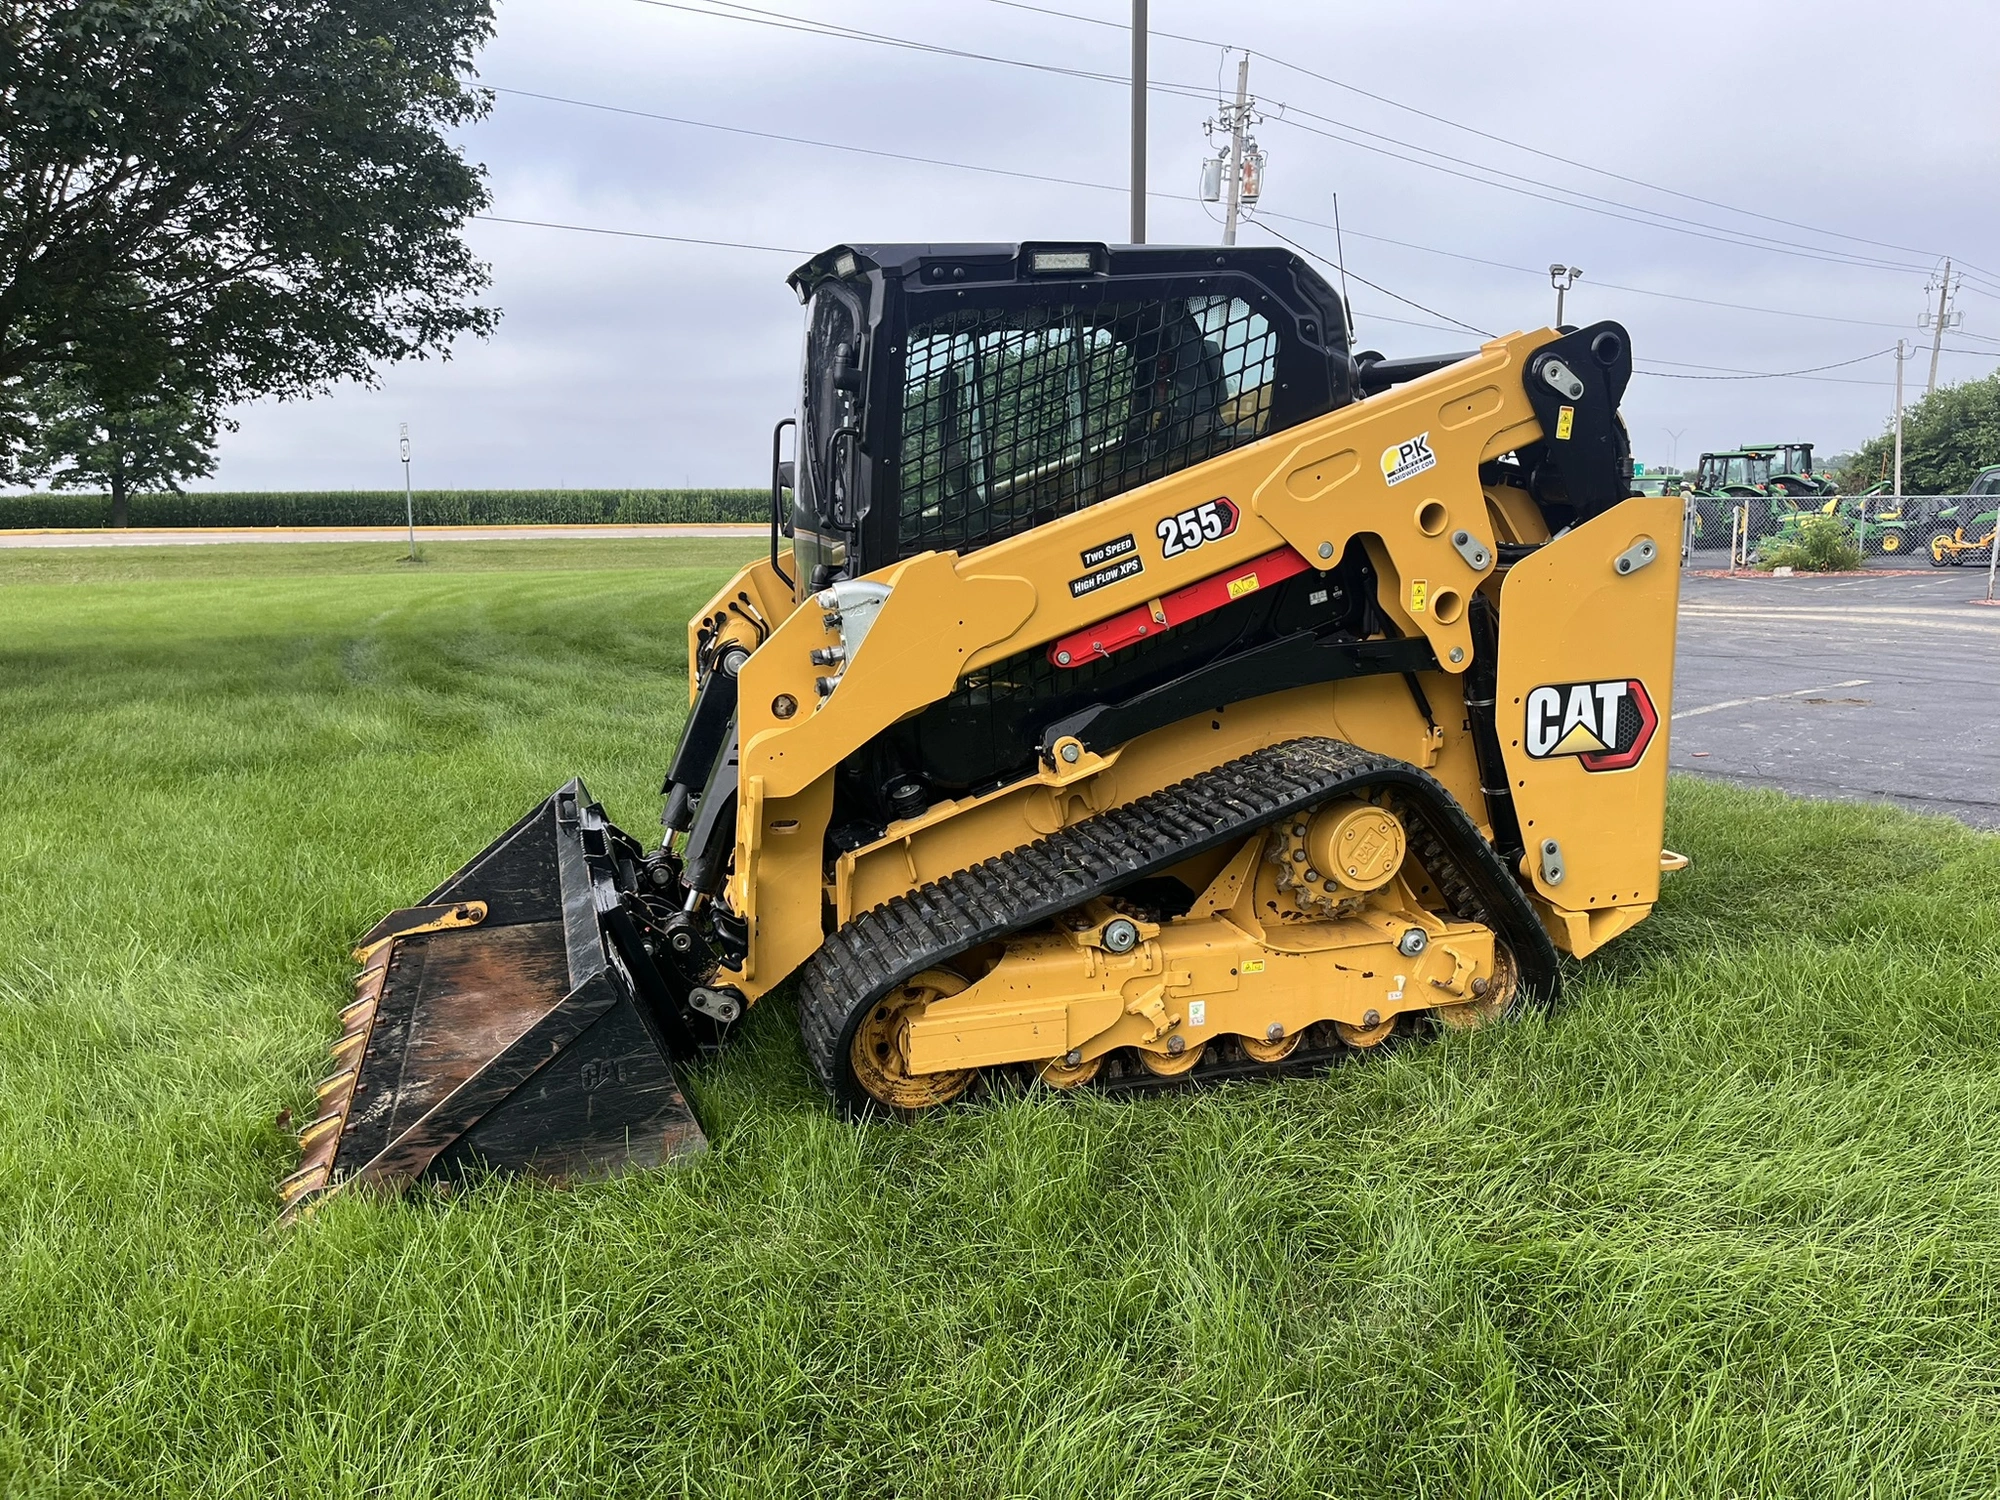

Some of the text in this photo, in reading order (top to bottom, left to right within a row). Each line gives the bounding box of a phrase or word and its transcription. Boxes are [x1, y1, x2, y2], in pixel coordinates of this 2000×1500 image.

[1387, 459, 1435, 485] PKMIDWEST.COM
[1157, 502, 1222, 557] 255
[1119, 560, 1139, 576] XPS
[1526, 681, 1627, 757] CAT
[1353, 832, 1379, 865] CAT
[579, 1060, 629, 1092] CAT
